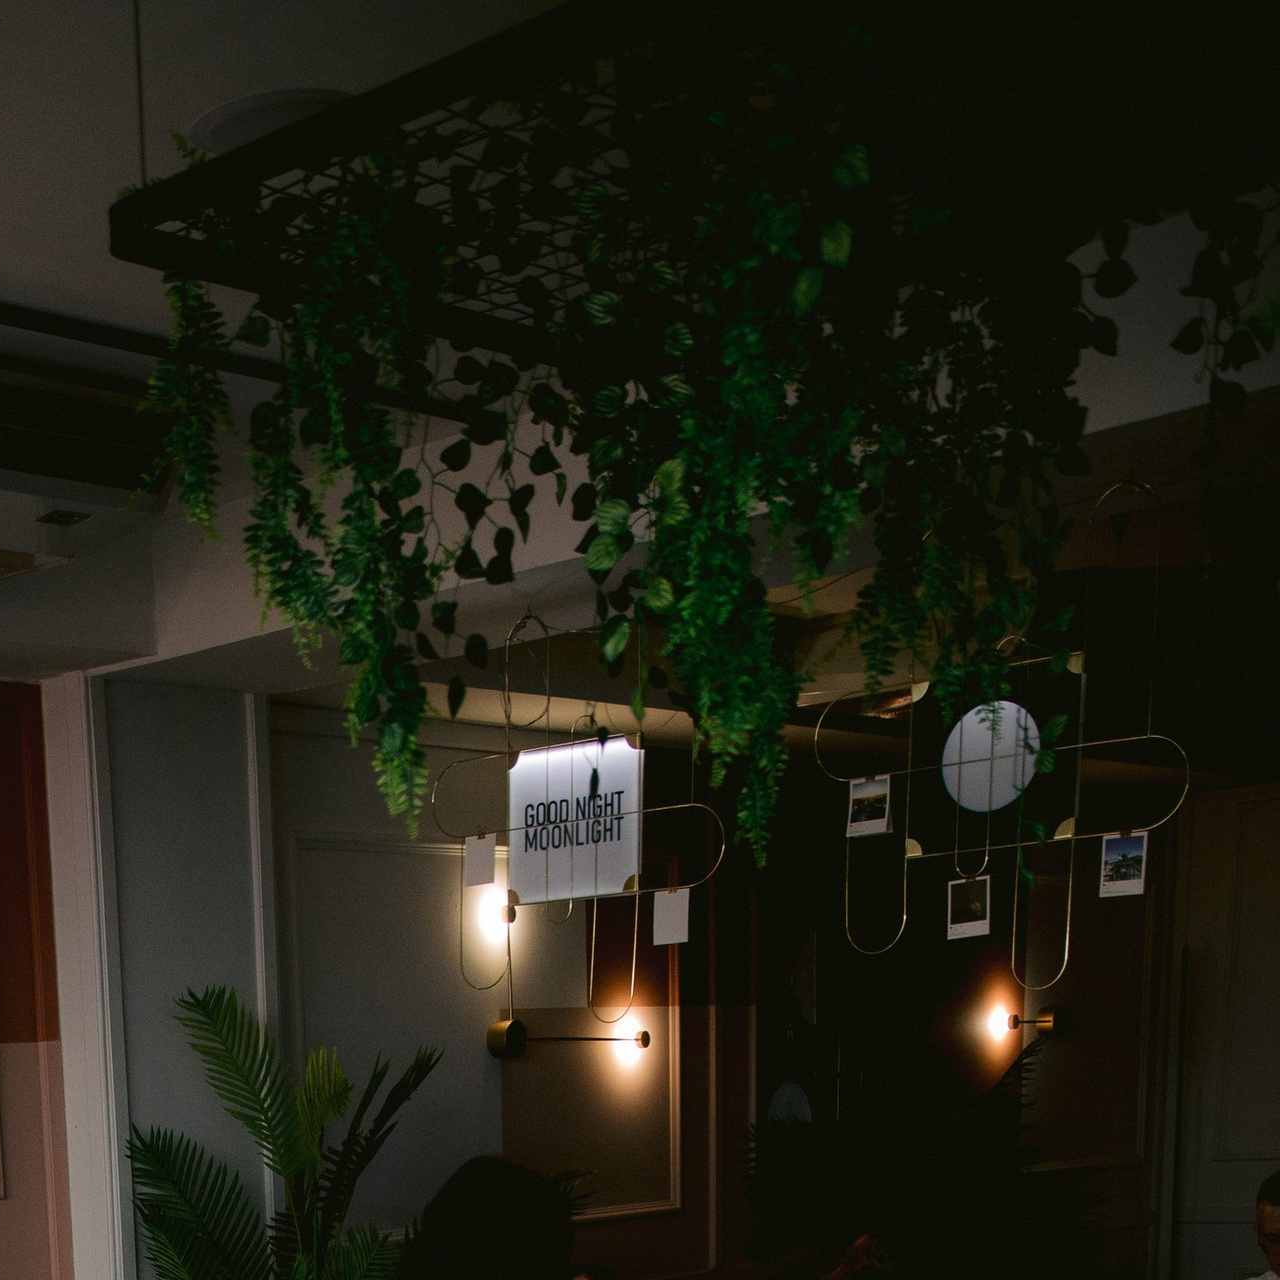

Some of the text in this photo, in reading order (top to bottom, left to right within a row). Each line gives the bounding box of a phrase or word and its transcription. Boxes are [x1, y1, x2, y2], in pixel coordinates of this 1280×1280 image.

[524, 790, 625, 828] GOOD NIGHT
[524, 816, 625, 853] MOONLIGHT
